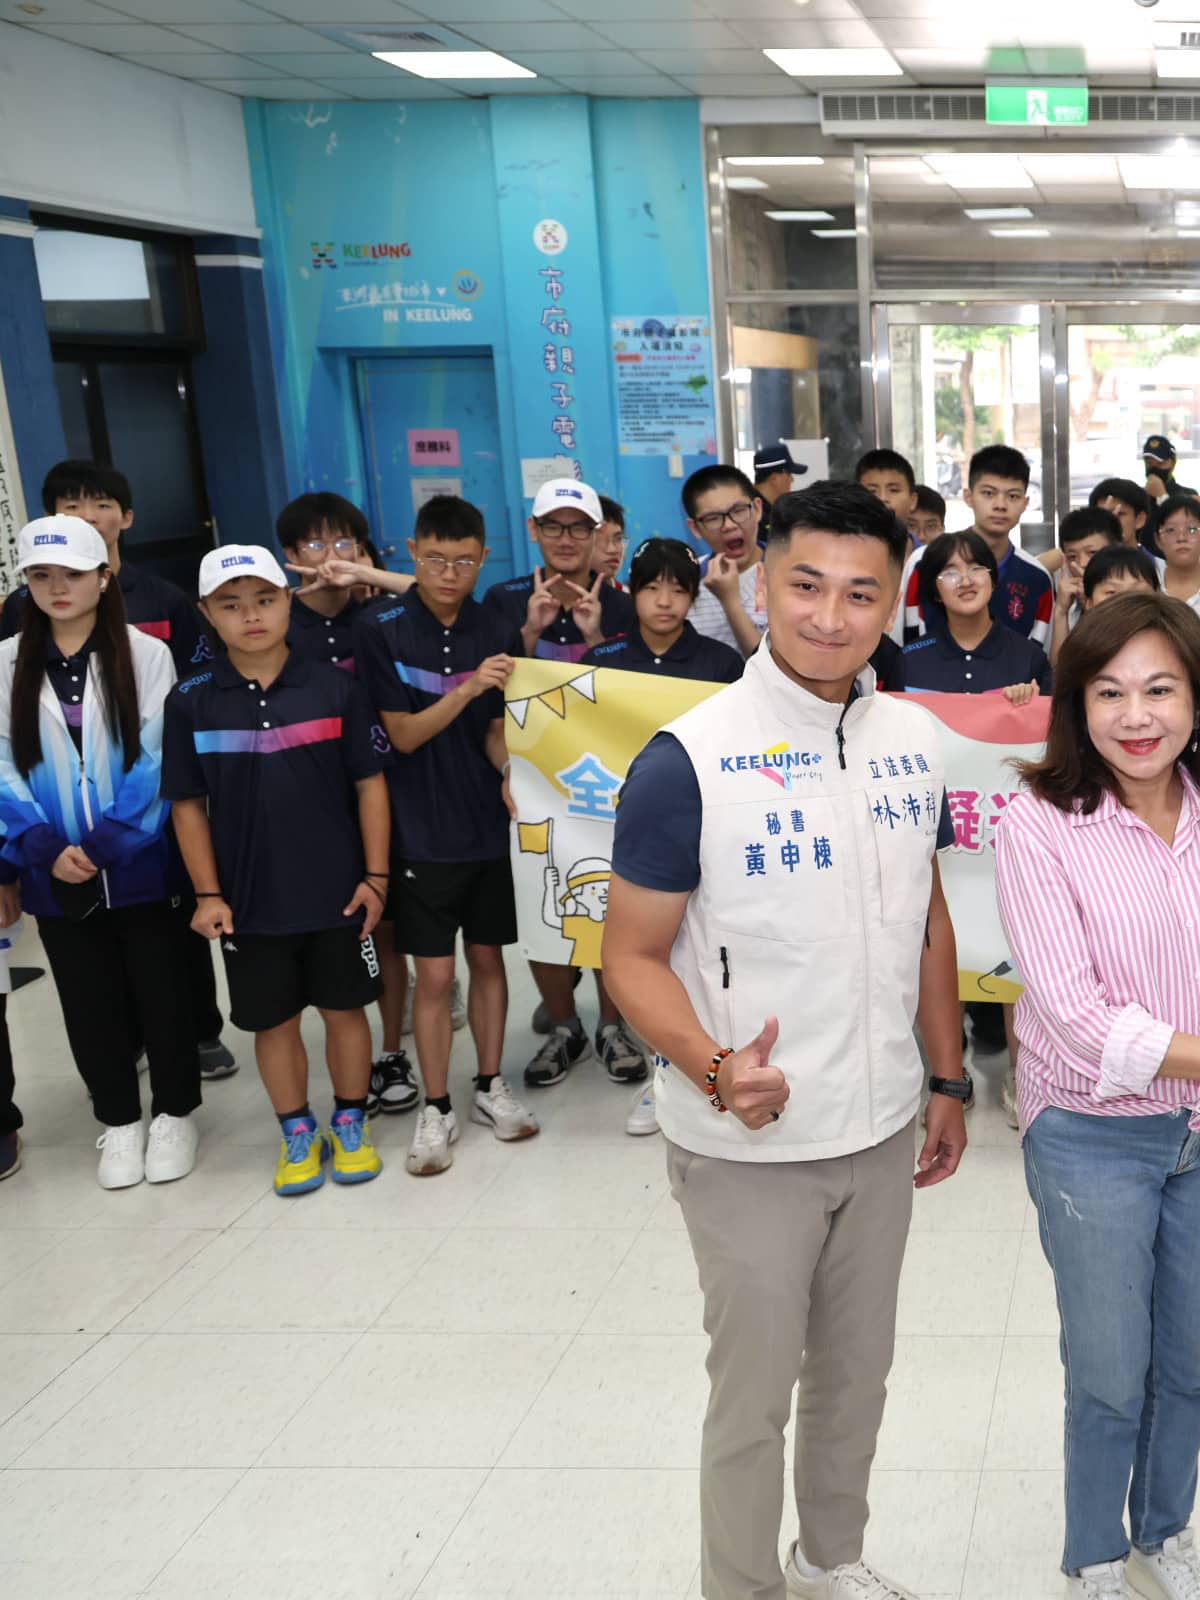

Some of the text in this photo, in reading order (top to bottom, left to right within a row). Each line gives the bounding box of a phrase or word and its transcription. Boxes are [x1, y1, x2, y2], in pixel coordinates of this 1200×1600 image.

[343, 242, 412, 259] KEELUNG
[406, 307, 473, 322] KEELUNG
[868, 753, 931, 779] 立法委員
[766, 809, 805, 835] 秘書
[873, 791, 936, 830] 林沛祥
[745, 836, 833, 877] 黃申棟
[360, 934, 380, 978] ppa
